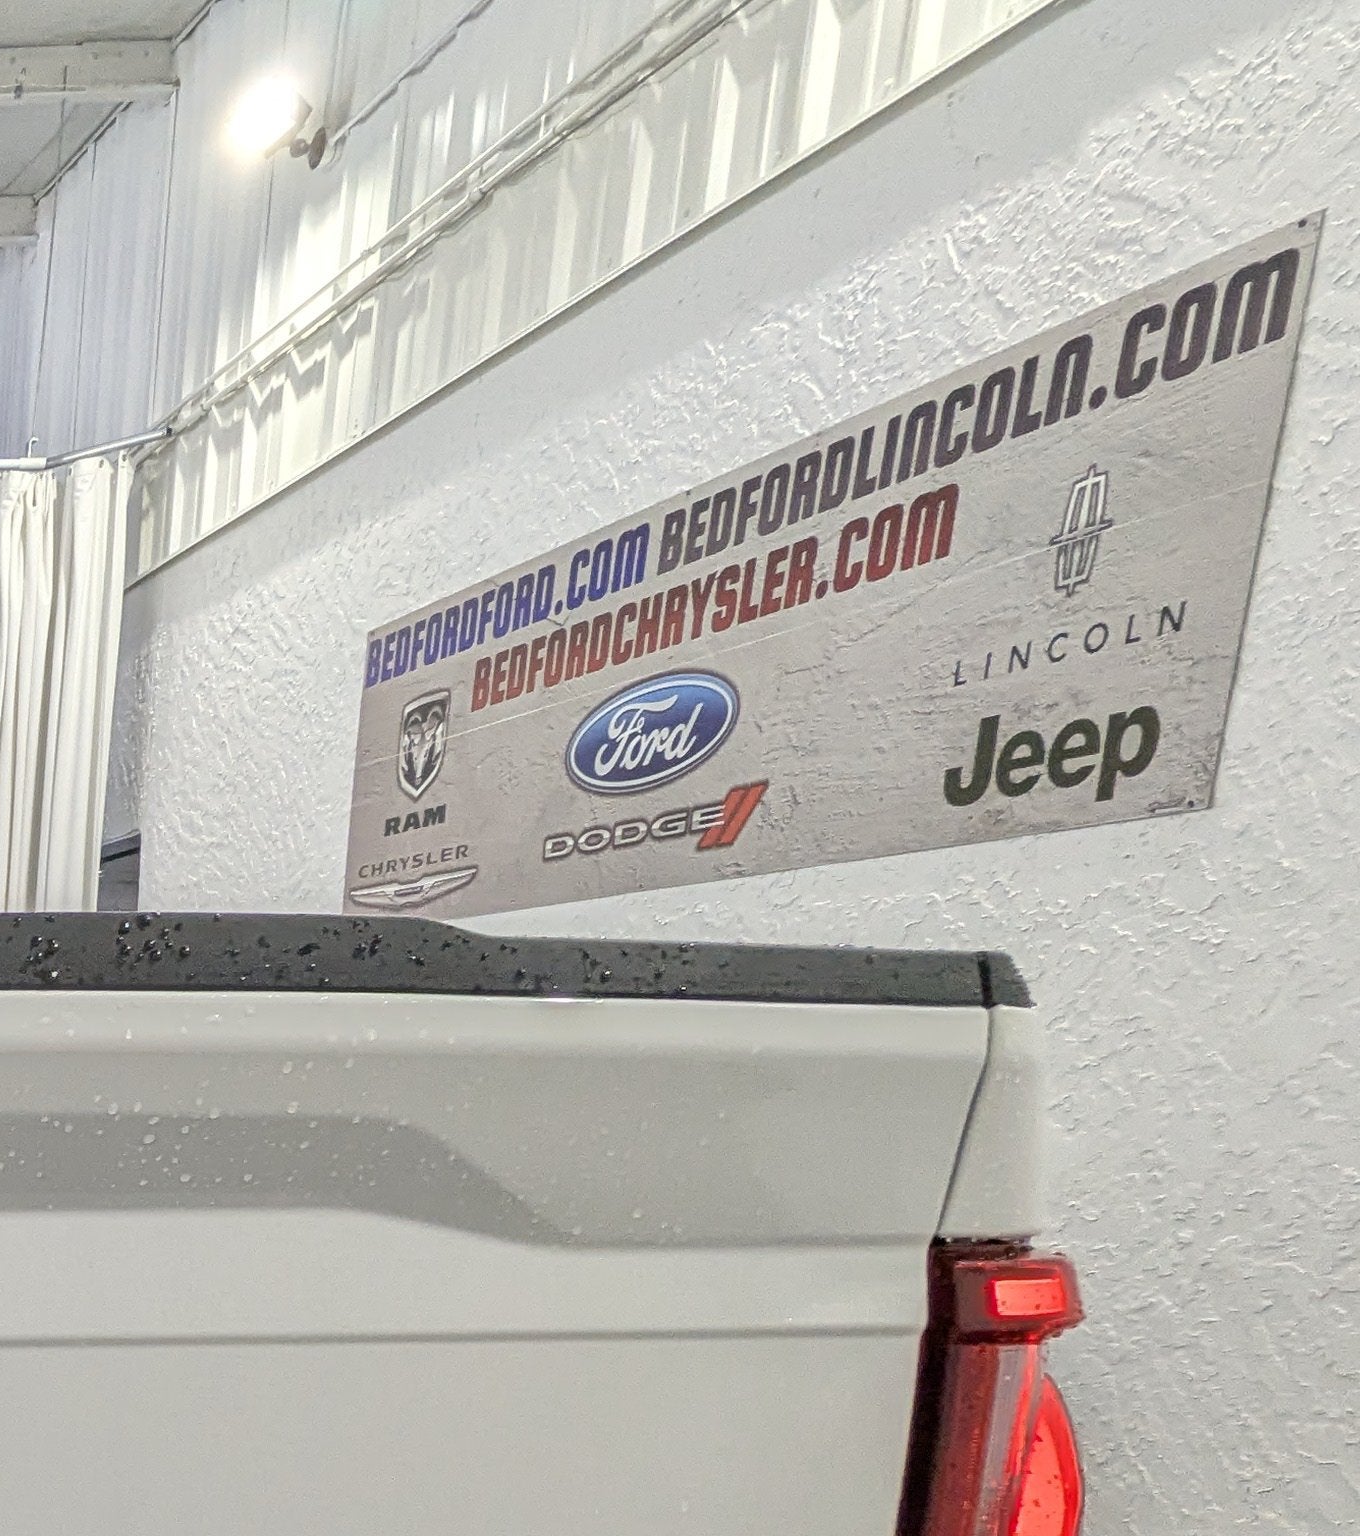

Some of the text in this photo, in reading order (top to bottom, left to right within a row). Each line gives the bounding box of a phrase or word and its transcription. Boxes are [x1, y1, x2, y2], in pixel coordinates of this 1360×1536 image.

[365, 246, 1300, 688] BEDFORDFORD.COM BEDFORDLINCOLN.COM
[471, 483, 959, 712] BEDFORDCHRYSLER.COM
[953, 601, 1187, 686] LINCOLN
[594, 694, 704, 776] Ford
[943, 705, 1161, 807] Jeep
[358, 844, 469, 879] CHRYSLER
[383, 803, 447, 837] RAM
[543, 803, 727, 861] DODGE
